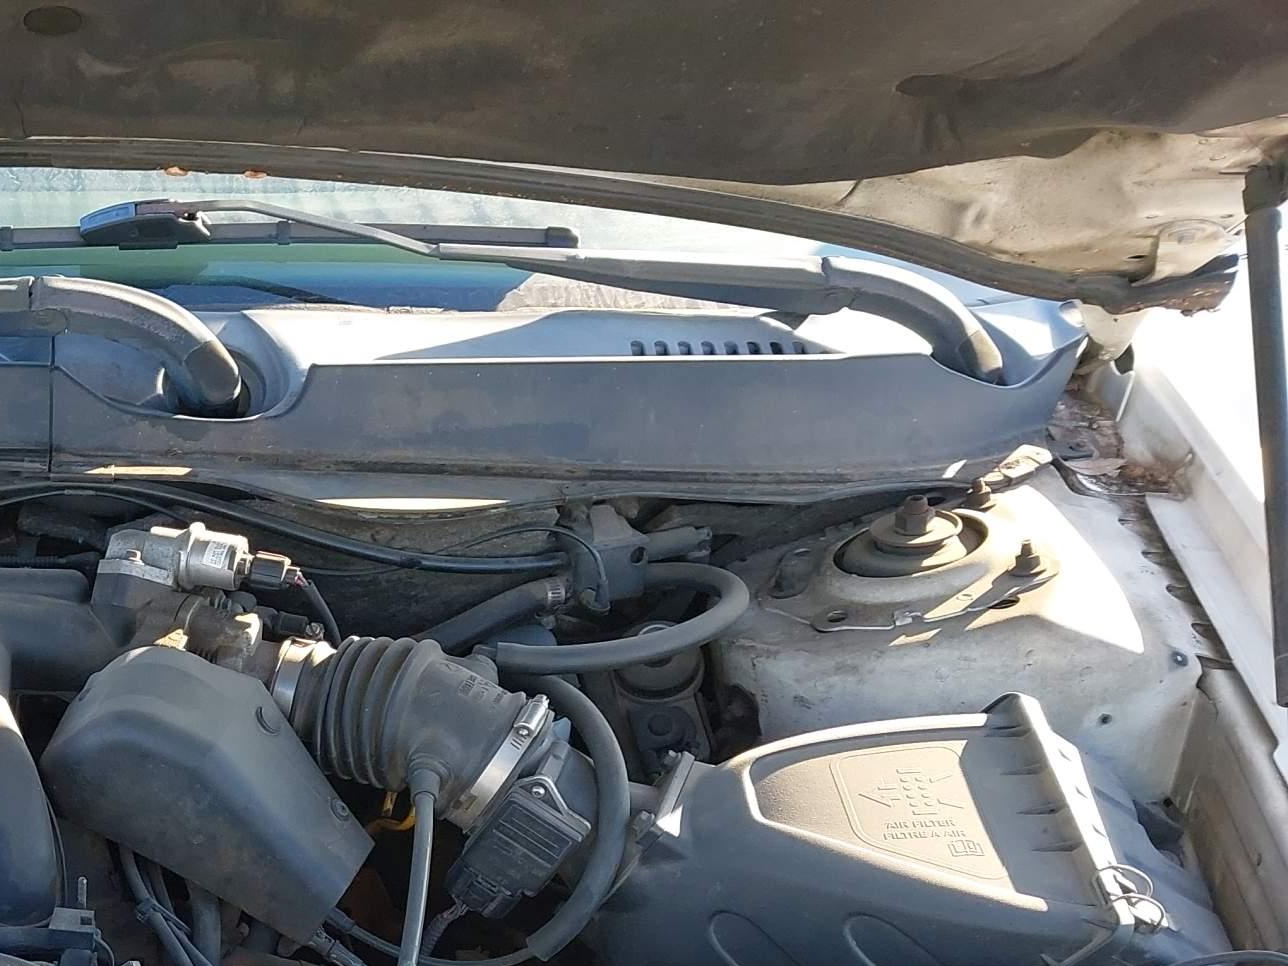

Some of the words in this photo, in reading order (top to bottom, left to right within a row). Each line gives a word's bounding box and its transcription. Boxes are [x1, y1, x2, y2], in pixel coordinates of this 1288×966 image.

[885, 820, 909, 830] AIR
[912, 818, 956, 828] FILTER
[944, 830, 966, 838] AIR
